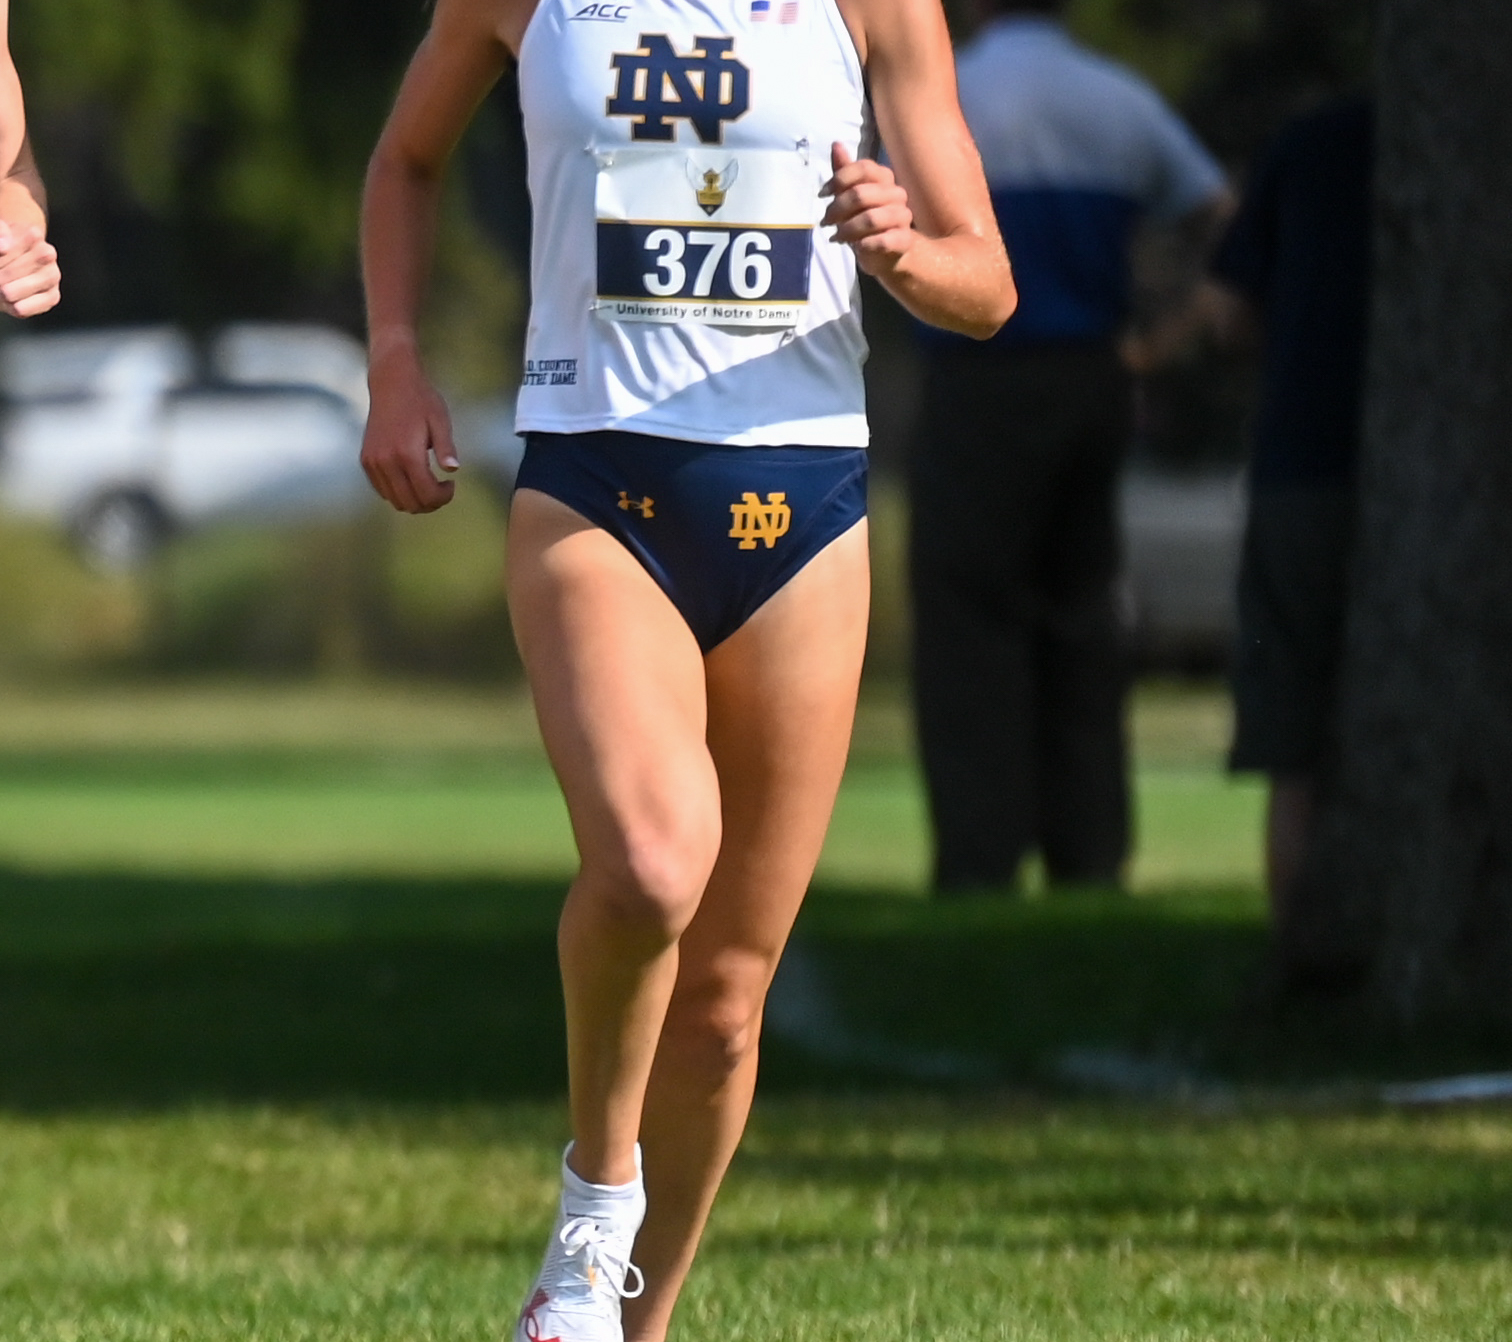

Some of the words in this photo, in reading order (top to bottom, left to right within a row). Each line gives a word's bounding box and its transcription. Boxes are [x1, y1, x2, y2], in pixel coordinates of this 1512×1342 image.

[575, 2, 632, 19] ACC
[642, 227, 773, 300] 376
[616, 302, 687, 319] University
[692, 306, 708, 318] of
[713, 307, 753, 319] Notre
